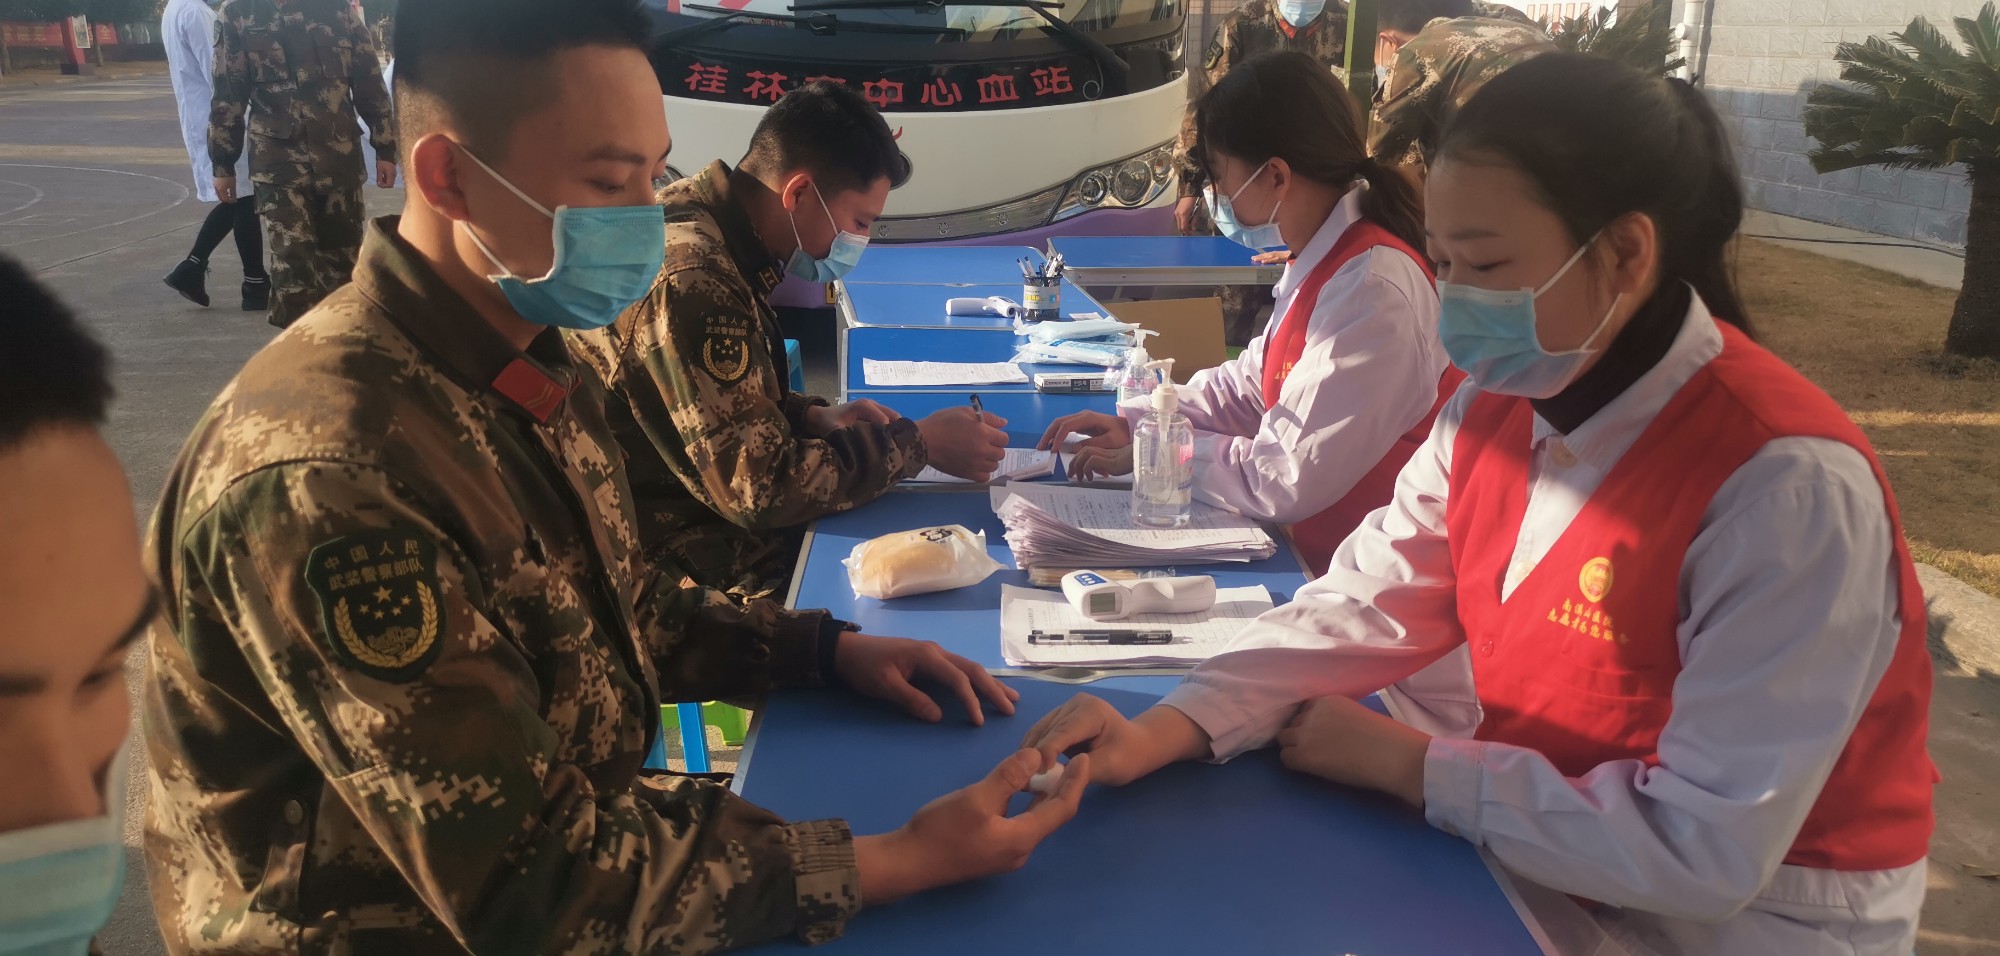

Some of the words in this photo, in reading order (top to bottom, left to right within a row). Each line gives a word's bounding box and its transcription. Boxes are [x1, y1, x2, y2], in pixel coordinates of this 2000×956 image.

[684, 61, 1075, 109] 桂林中心血站
[324, 539, 420, 570] 中国人民
[329, 557, 424, 591] 武装警察部队
